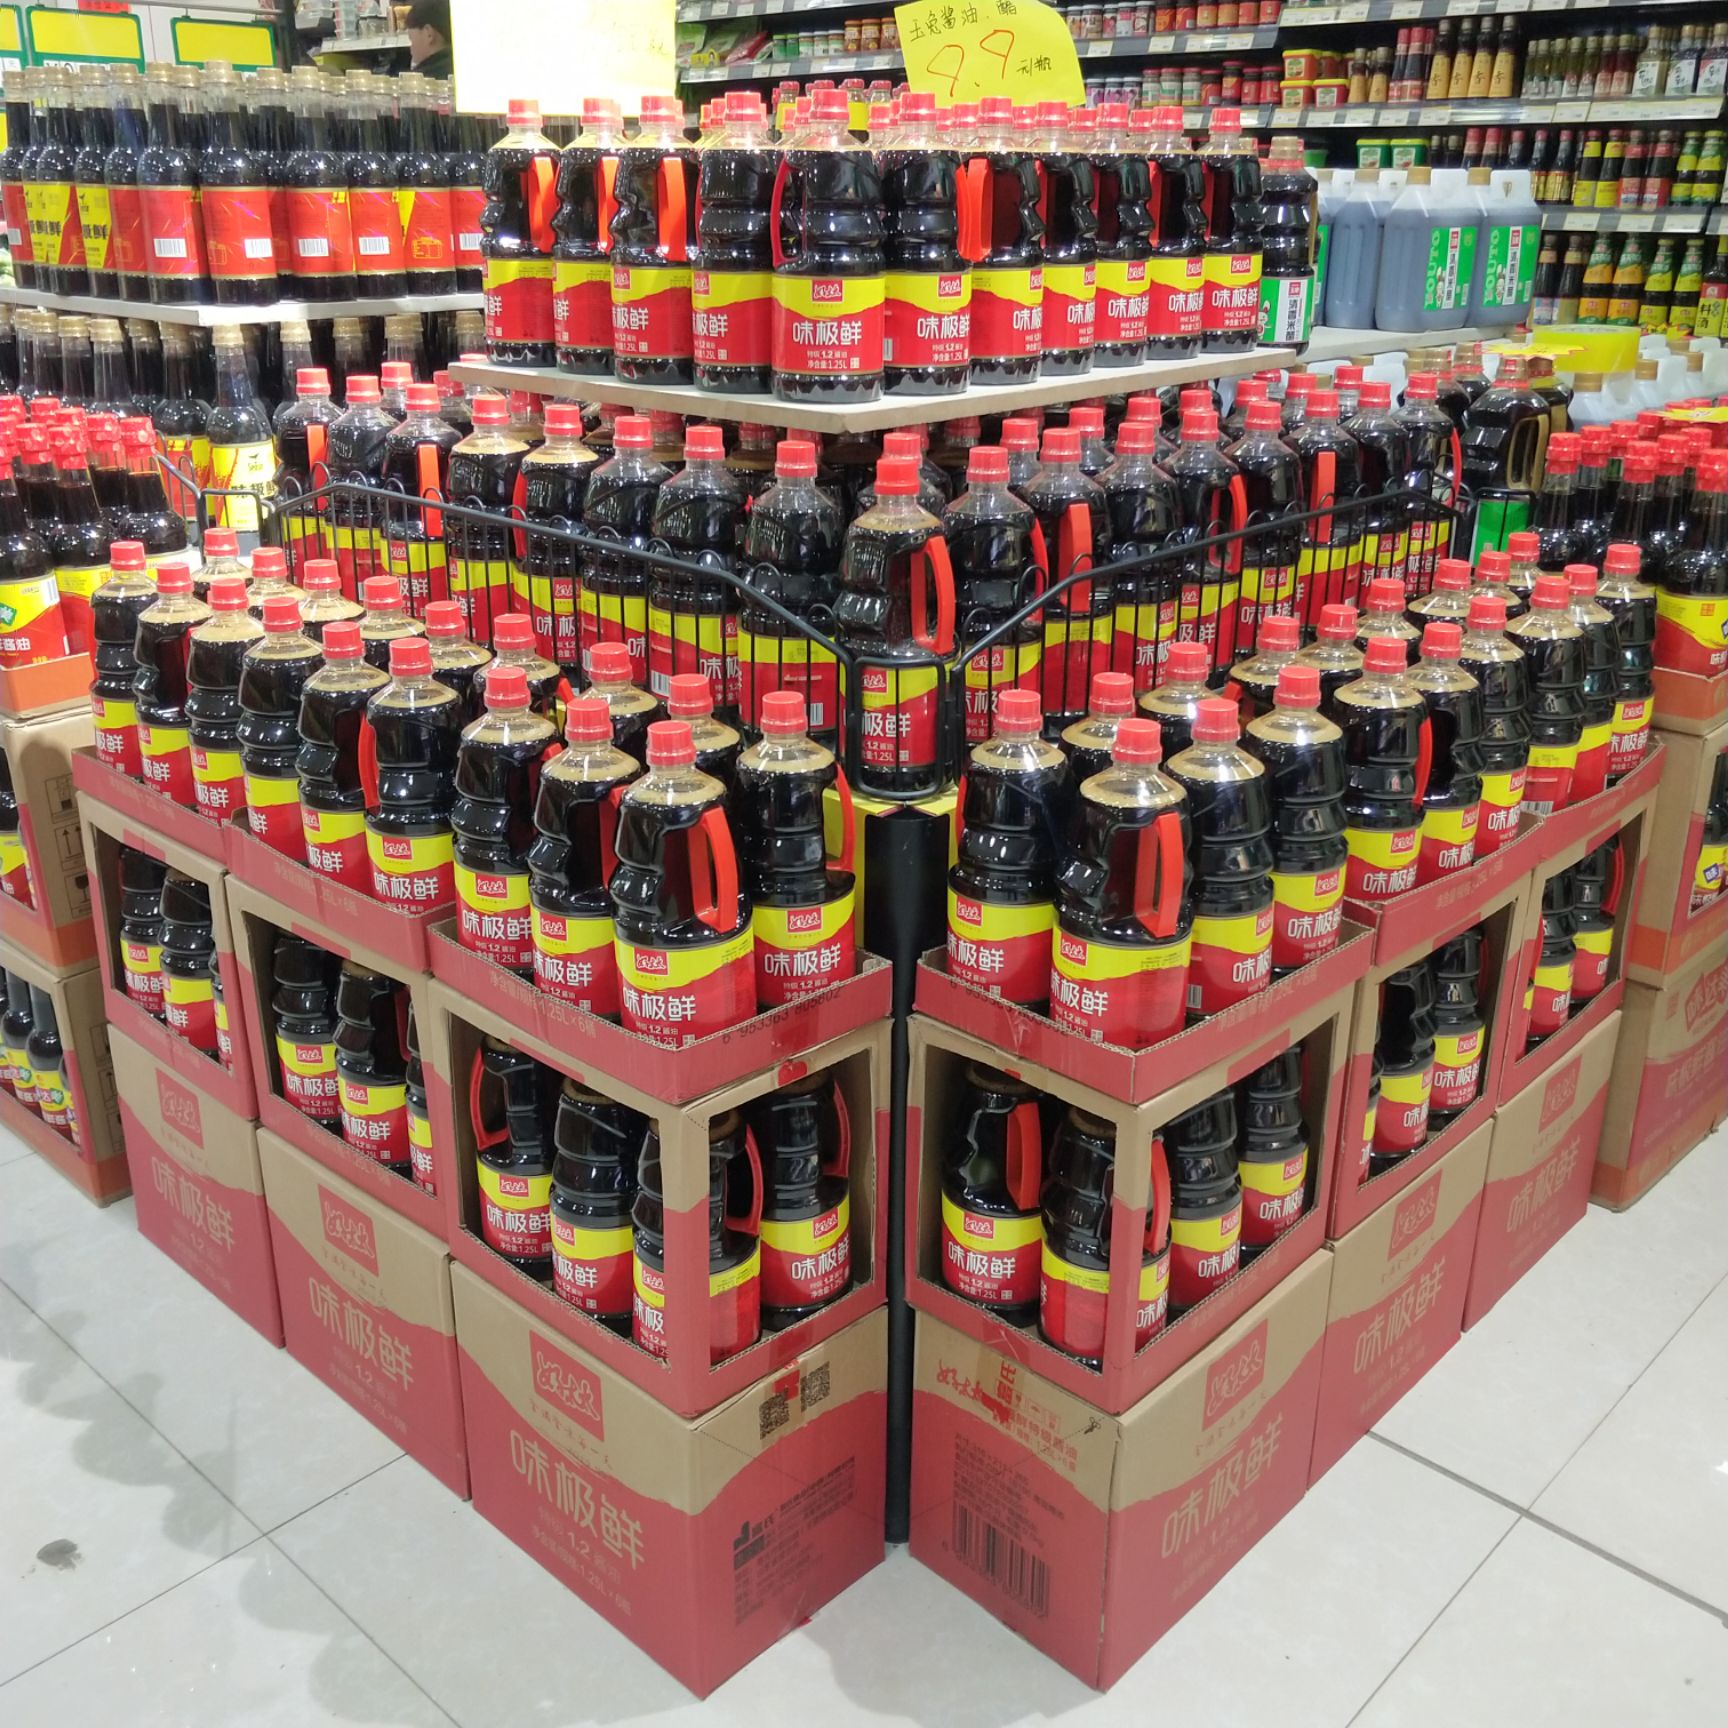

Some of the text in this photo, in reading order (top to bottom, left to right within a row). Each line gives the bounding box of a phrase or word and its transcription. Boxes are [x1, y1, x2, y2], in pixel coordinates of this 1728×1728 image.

[793, 320, 862, 345] 味极鲜
[374, 871, 439, 900] 味极鲜
[462, 909, 532, 941] 味极鲜
[764, 943, 842, 977] 味极鲜
[623, 986, 696, 1022] 味极鲜
[151, 1156, 236, 1252] 味极鲜
[487, 1205, 551, 1234] 味极鲜
[791, 1232, 849, 1281] 味极鲜
[948, 1241, 1016, 1279] 味极鲜
[1353, 1255, 1446, 1374] 味极鲜
[308, 1276, 414, 1392] 味极鲜
[510, 1429, 645, 1571] 味极鲜
[1161, 1411, 1283, 1559] 味极鲜
